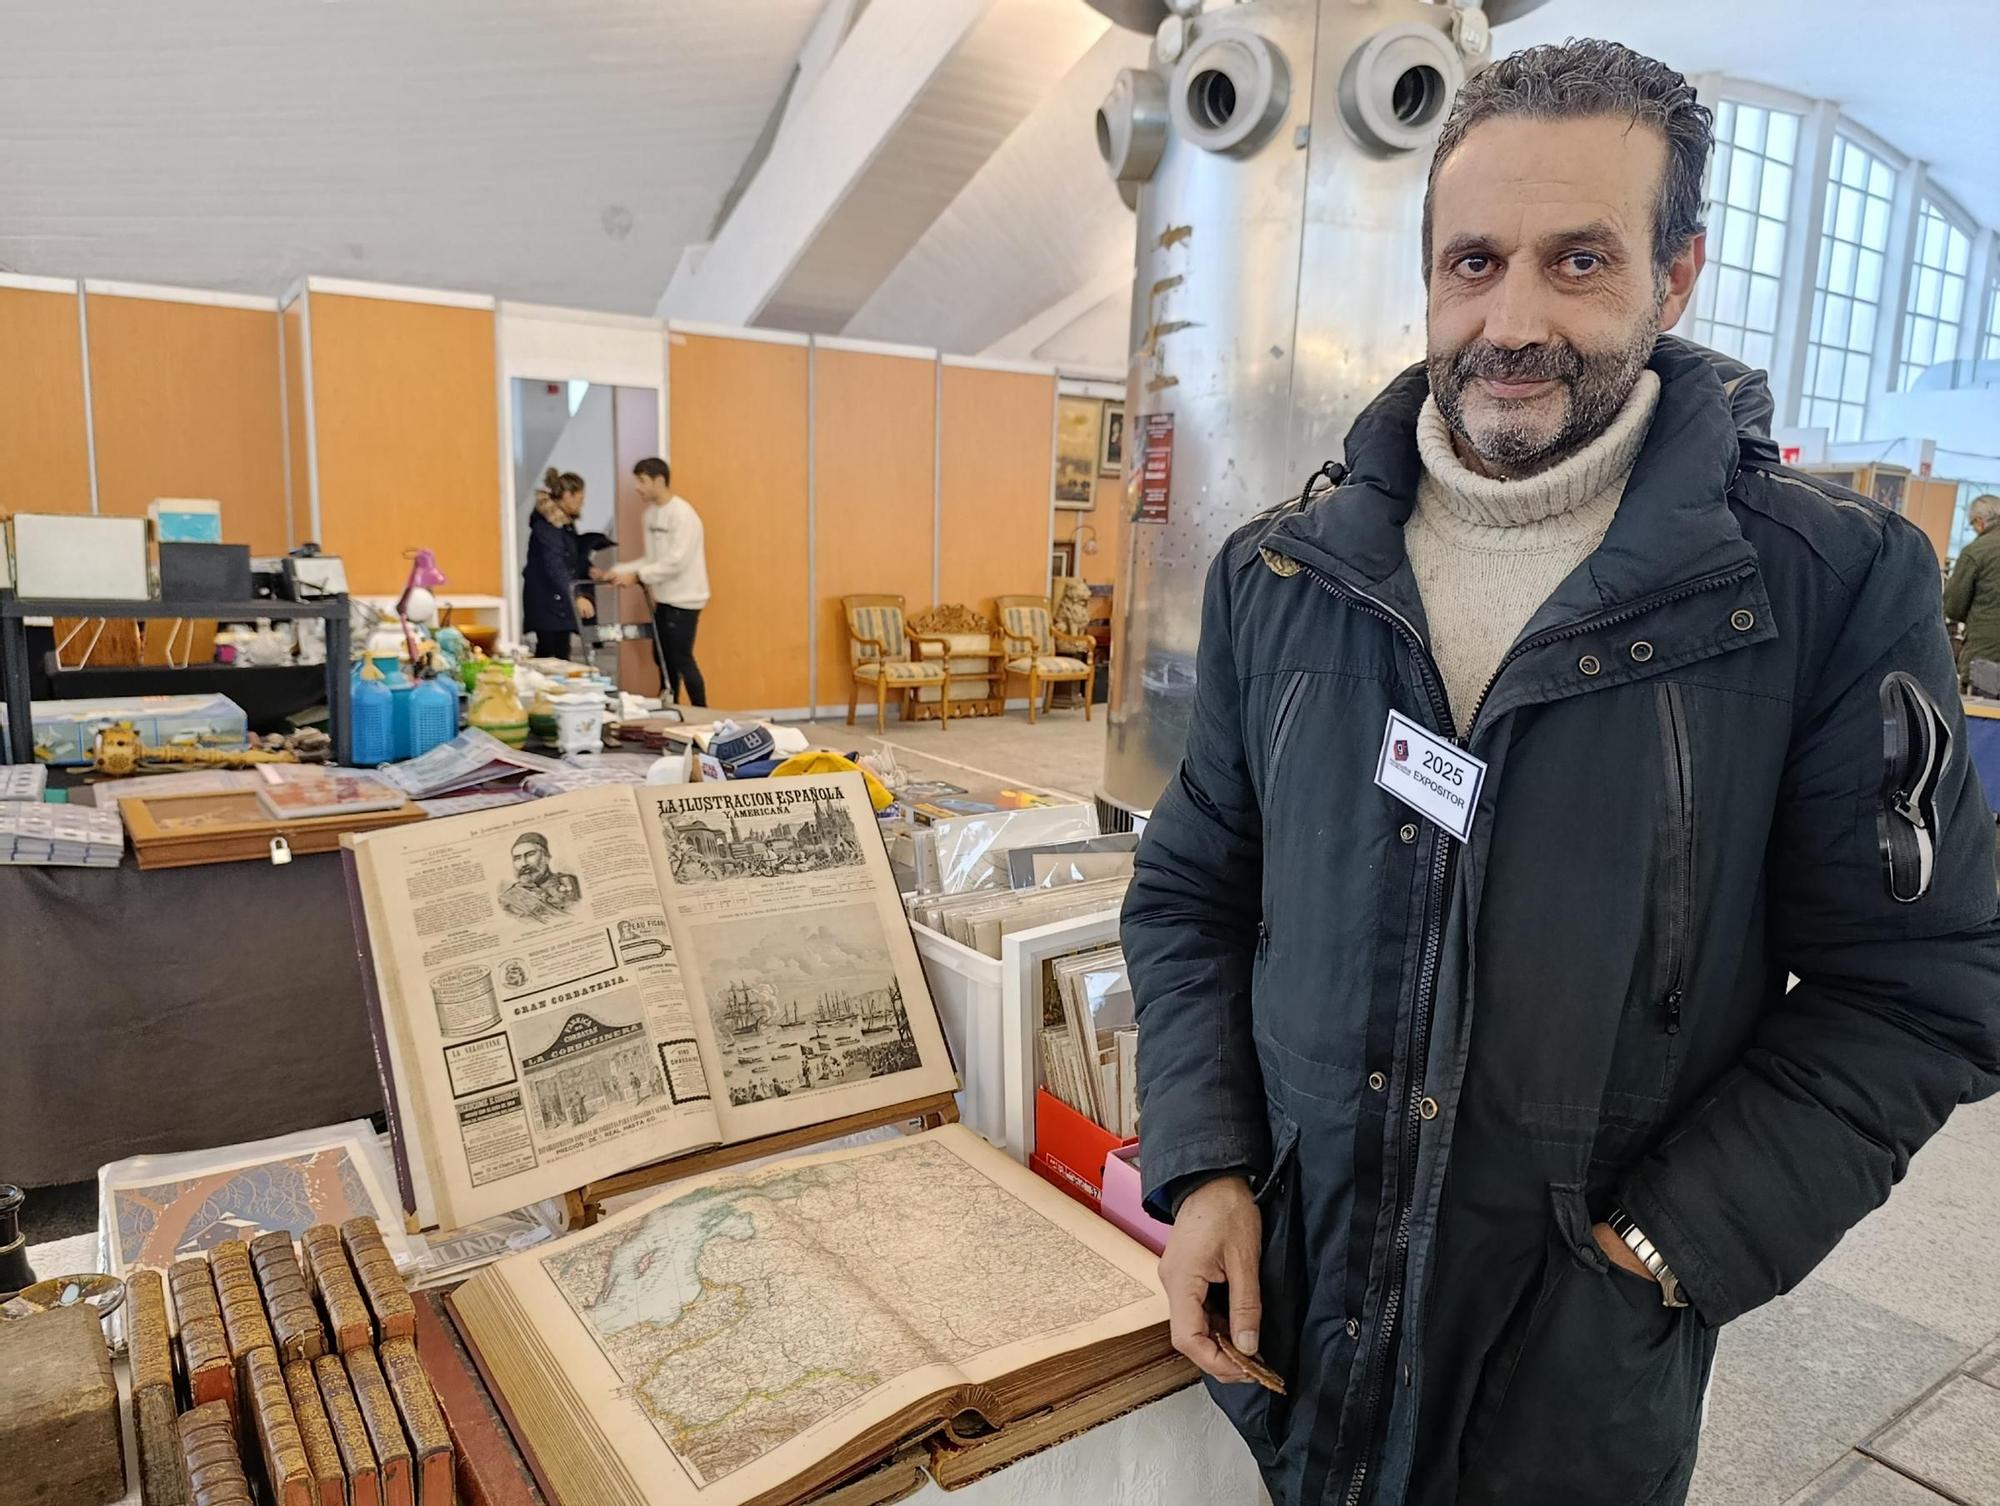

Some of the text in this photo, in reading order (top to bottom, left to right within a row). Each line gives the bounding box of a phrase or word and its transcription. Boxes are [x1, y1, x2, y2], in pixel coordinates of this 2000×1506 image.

[1423, 750, 1464, 786] 2025
[657, 786, 845, 817] LA ILUSTRACION ESPAÑOLA
[1413, 770, 1465, 809] EXPOSITOR
[733, 806, 791, 818] AMERICANA
[514, 1000, 547, 1016] GRAN
[528, 1024, 639, 1067] LA CORBATINERA
